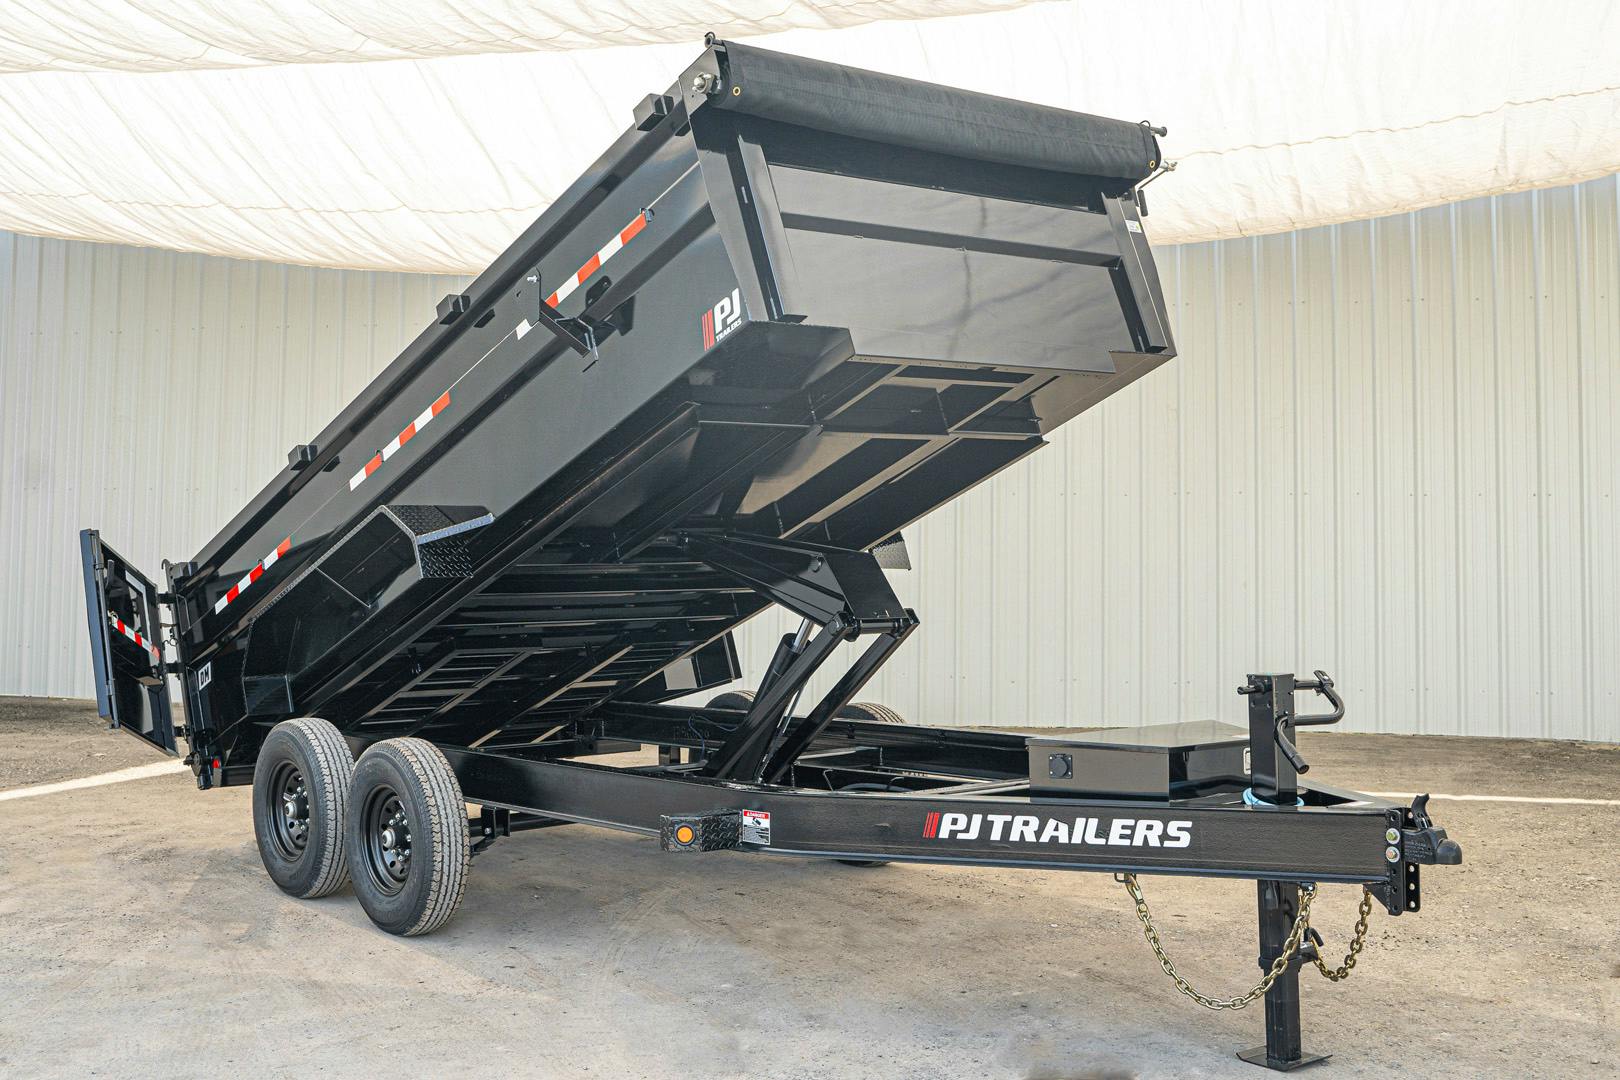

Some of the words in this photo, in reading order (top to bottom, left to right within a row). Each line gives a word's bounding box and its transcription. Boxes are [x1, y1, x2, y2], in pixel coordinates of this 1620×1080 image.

[714, 288, 741, 335] PJ
[716, 317, 742, 342] TRAILERS
[938, 813, 983, 839] PJ
[987, 814, 1192, 848] TRAILERS
